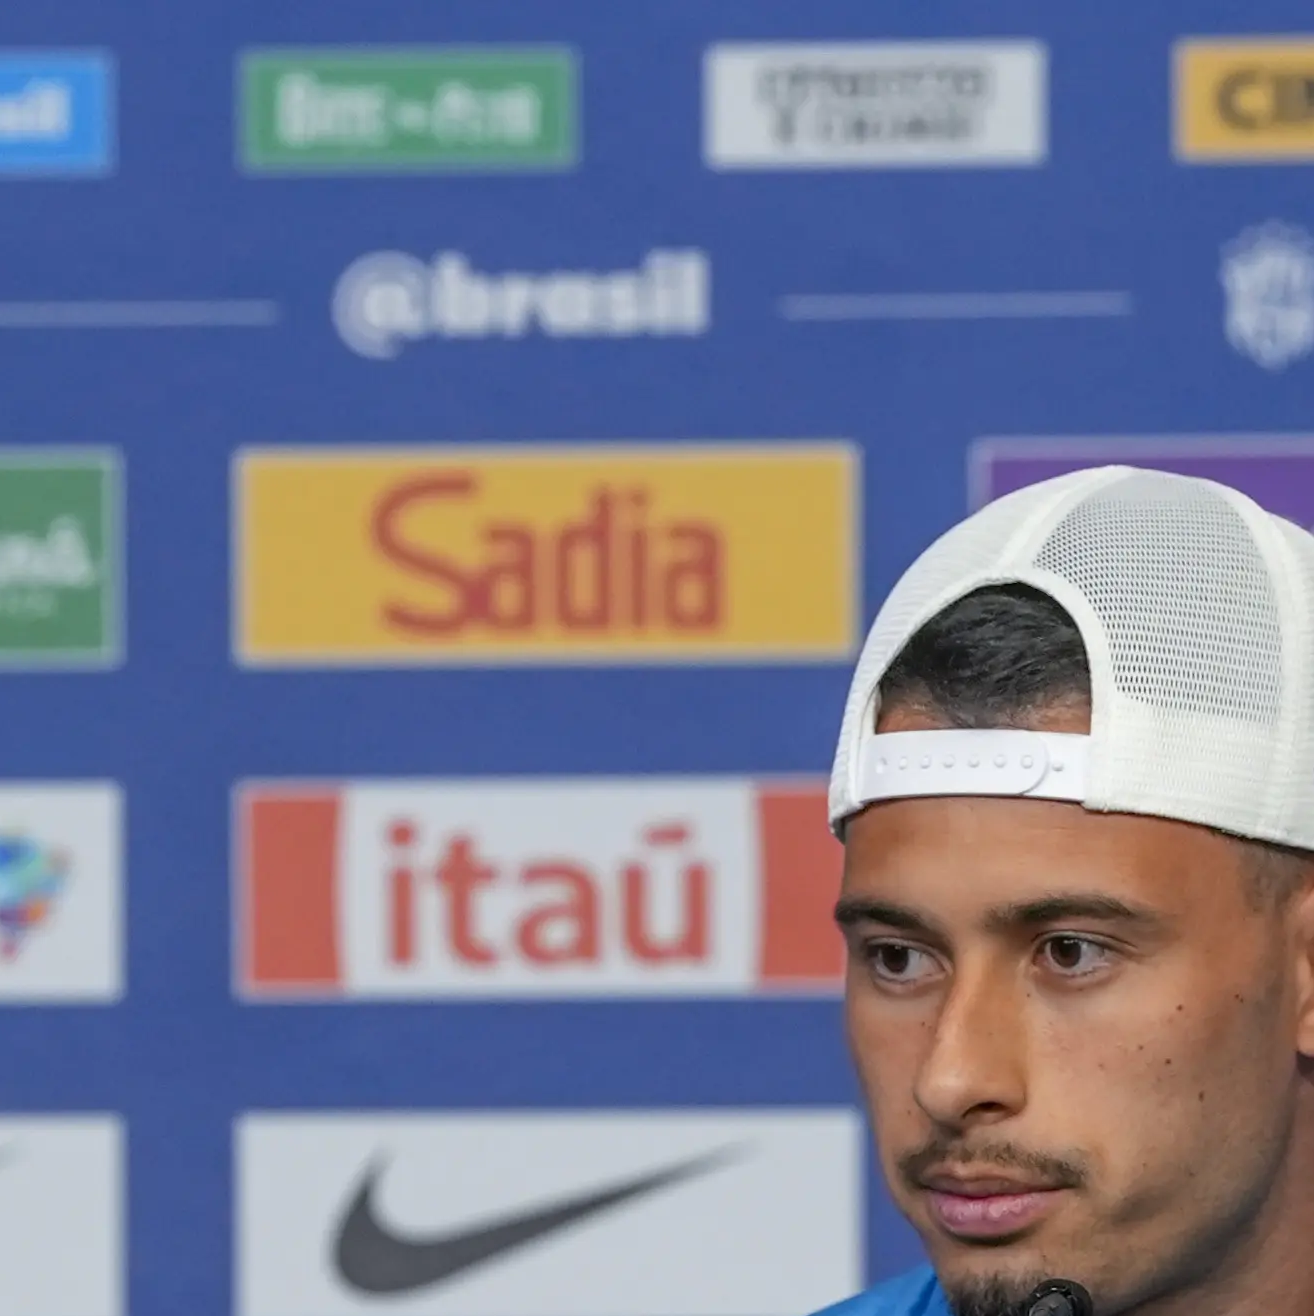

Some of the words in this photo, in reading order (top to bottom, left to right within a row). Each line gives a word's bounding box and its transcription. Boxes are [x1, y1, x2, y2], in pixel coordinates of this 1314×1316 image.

[335, 252, 708, 356] @brasil
[368, 472, 726, 638] Sadia
[388, 820, 711, 968] itaú
